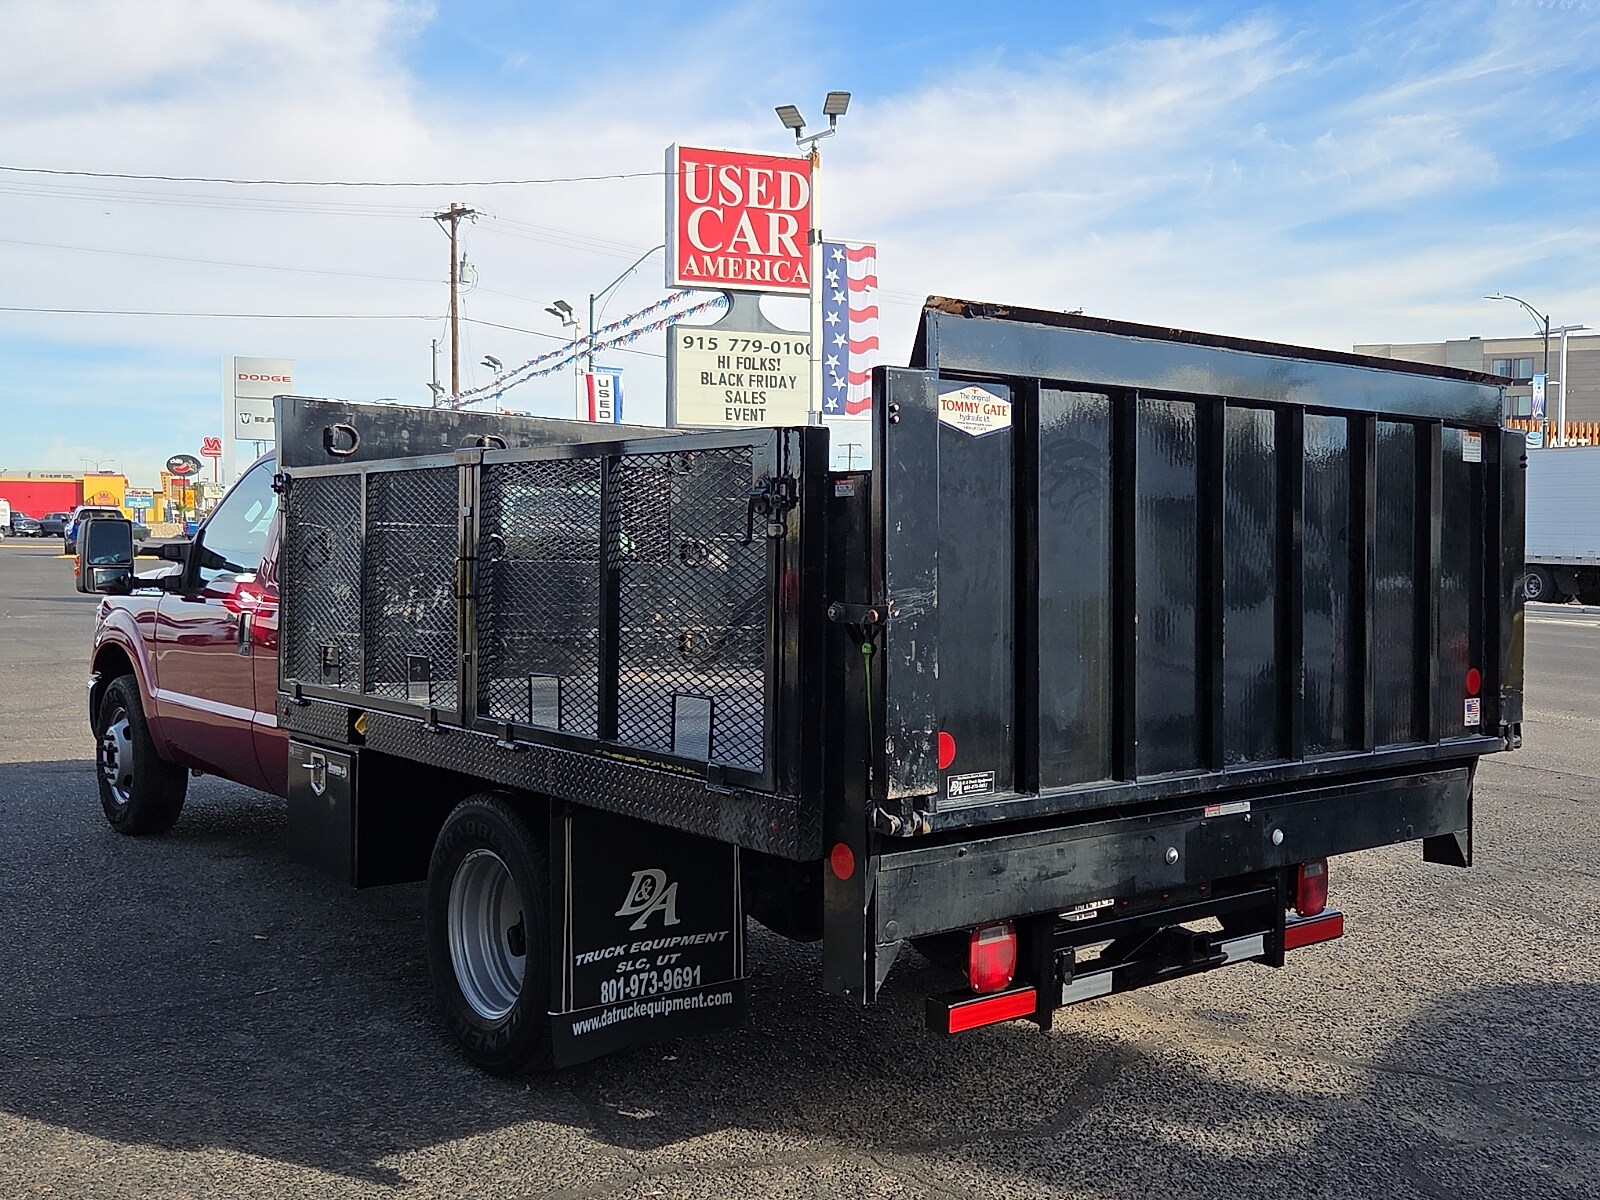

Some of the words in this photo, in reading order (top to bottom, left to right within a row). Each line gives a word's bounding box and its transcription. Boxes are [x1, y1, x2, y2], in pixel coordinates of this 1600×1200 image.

[682, 161, 810, 211] USED
[687, 206, 803, 258] CAR
[682, 254, 809, 284] AMERICA
[683, 335, 718, 351] 915
[717, 355, 730, 370] HI
[736, 356, 781, 372] FOLKS!
[238, 373, 292, 383] DODGE
[700, 372, 744, 387] BLACK
[749, 374, 797, 389] FRIDAY
[597, 379, 611, 419] USED
[725, 390, 767, 405] SALES
[940, 399, 980, 414] TOMMY
[983, 403, 1008, 416] GATE
[960, 392, 970, 400] The
[970, 394, 991, 403] original
[725, 407, 767, 422] EVENT
[614, 868, 681, 931] D&A
[575, 943, 628, 966] TRUCK
[629, 930, 730, 954] EQUIPMENT
[616, 957, 651, 973] SLC,
[656, 953, 682, 966] UT
[600, 964, 701, 1004] 801-973-9691
[572, 991, 733, 1036] www.datruckequipment.com
